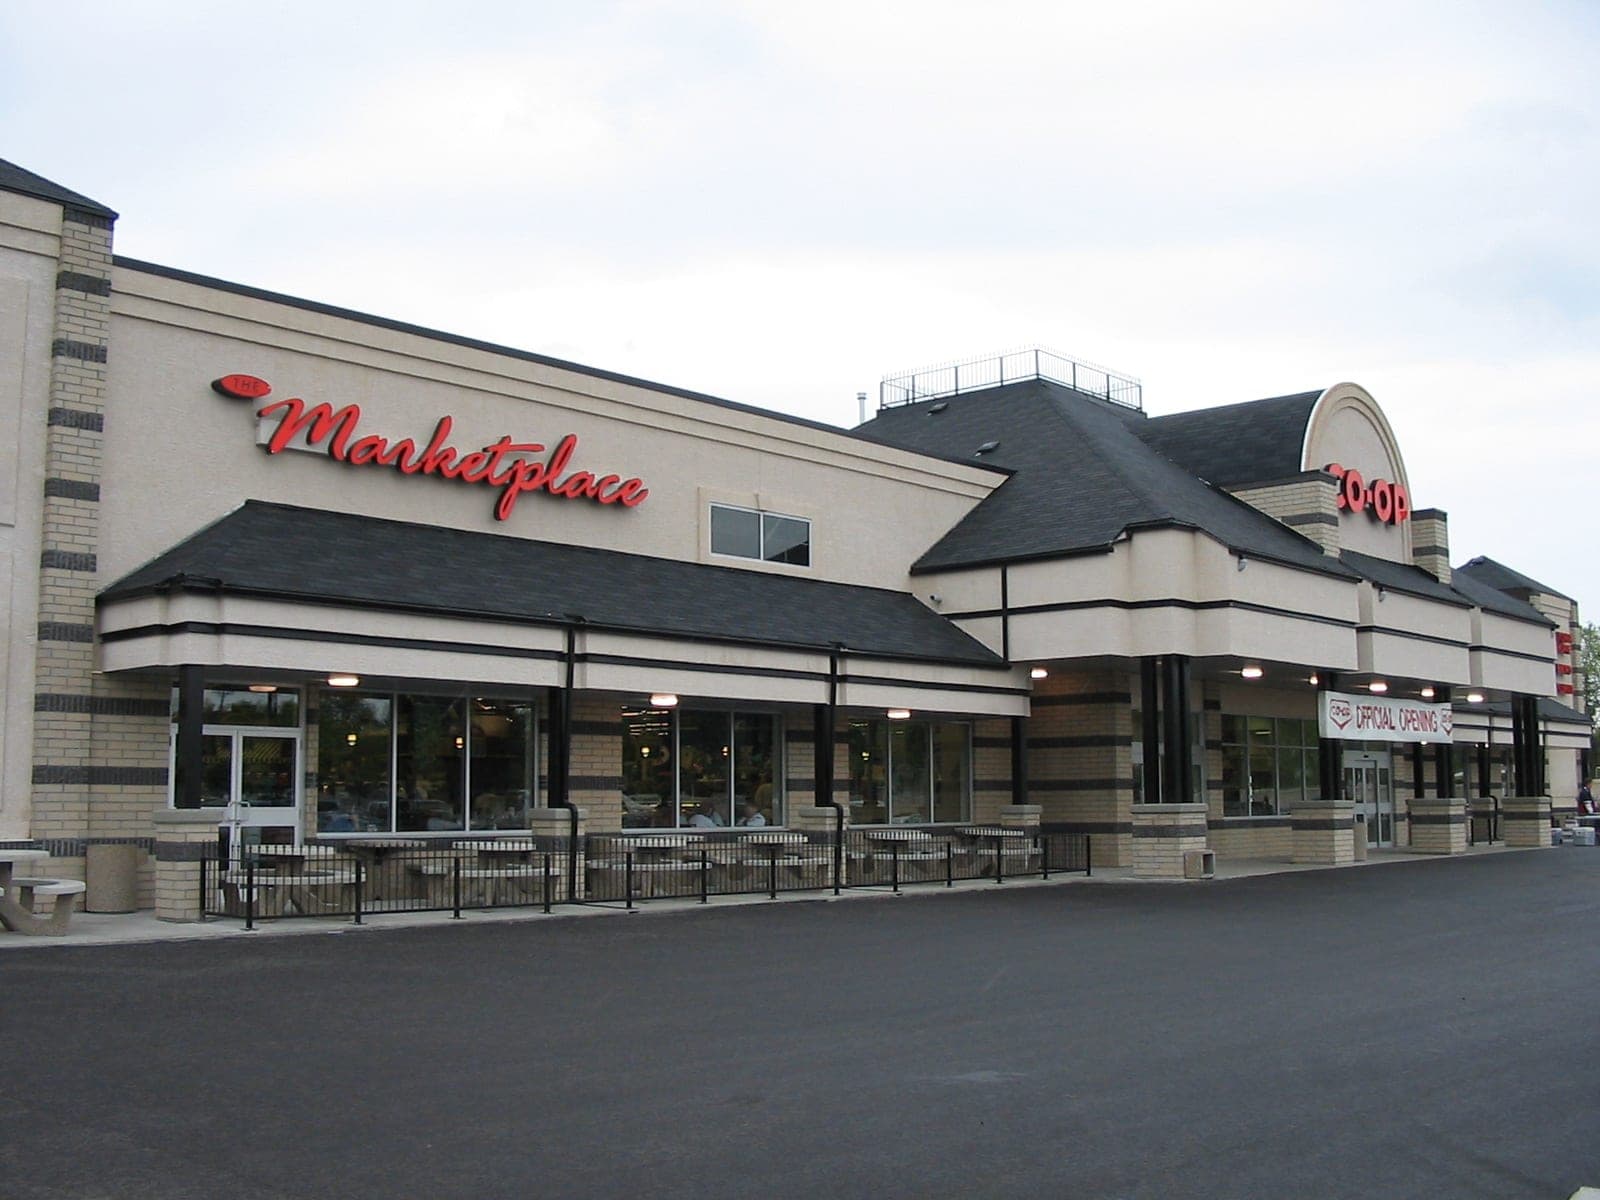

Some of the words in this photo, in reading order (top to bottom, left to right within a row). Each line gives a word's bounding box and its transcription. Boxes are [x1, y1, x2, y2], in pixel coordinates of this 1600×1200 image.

[233, 378, 259, 393] THE
[257, 397, 648, 521] Marketplace
[1356, 705, 1396, 731] OFFICIAL
[1400, 708, 1438, 732] OPENING
